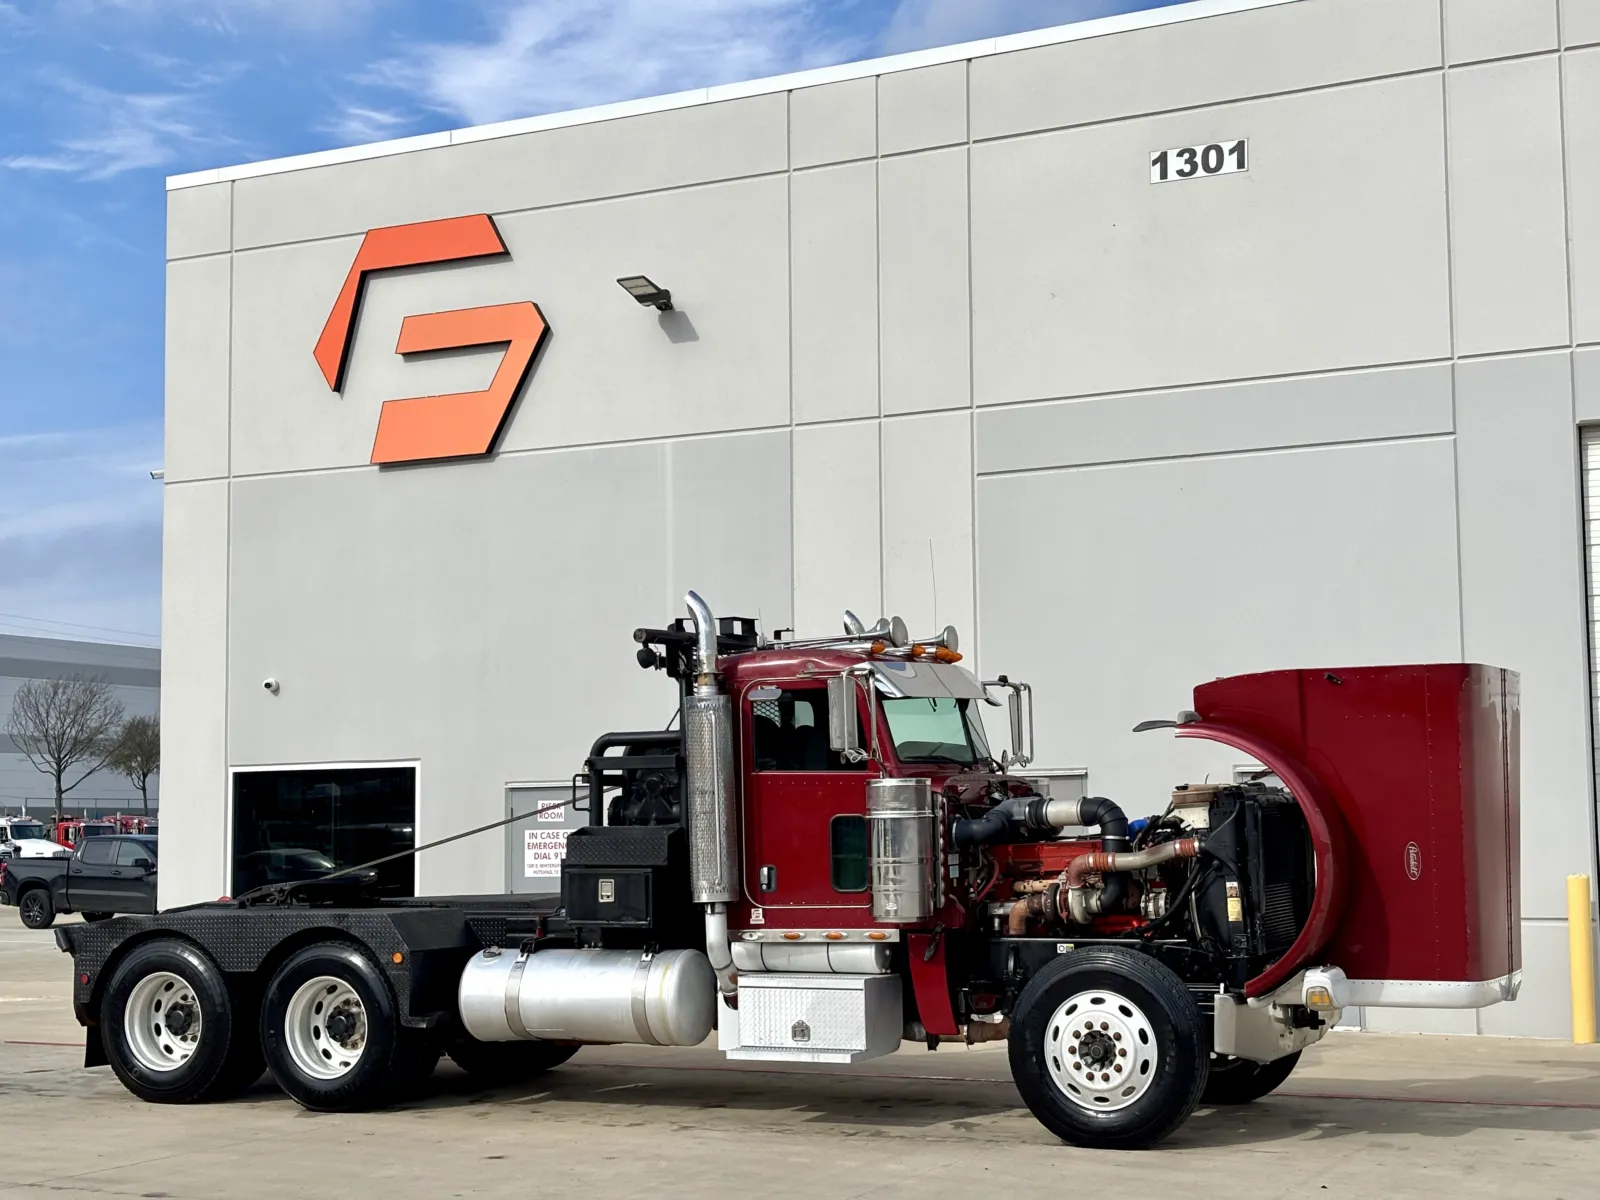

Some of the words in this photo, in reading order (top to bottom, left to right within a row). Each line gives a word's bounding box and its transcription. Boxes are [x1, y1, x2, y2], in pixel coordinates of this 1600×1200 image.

[1152, 140, 1246, 180] 1301
[528, 832, 538, 840] IN
[540, 832, 560, 840] CASE
